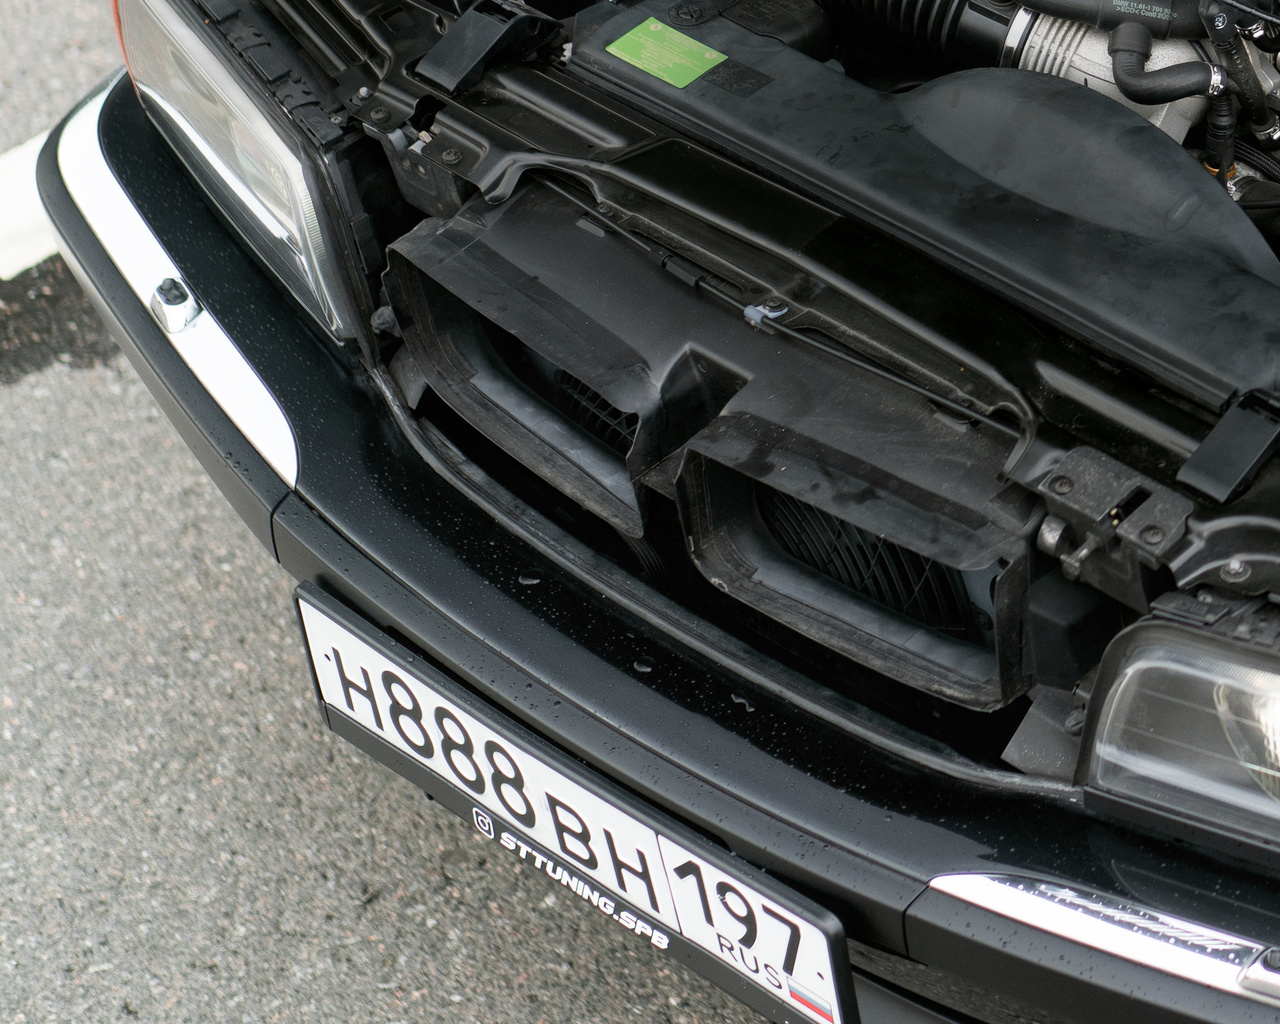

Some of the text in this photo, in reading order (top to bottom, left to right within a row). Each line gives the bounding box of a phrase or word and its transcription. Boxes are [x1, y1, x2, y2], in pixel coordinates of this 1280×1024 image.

[500, 831, 670, 950] STTUNING.SPB
[673, 860, 801, 976] 197
[716, 932, 782, 990] RUS
